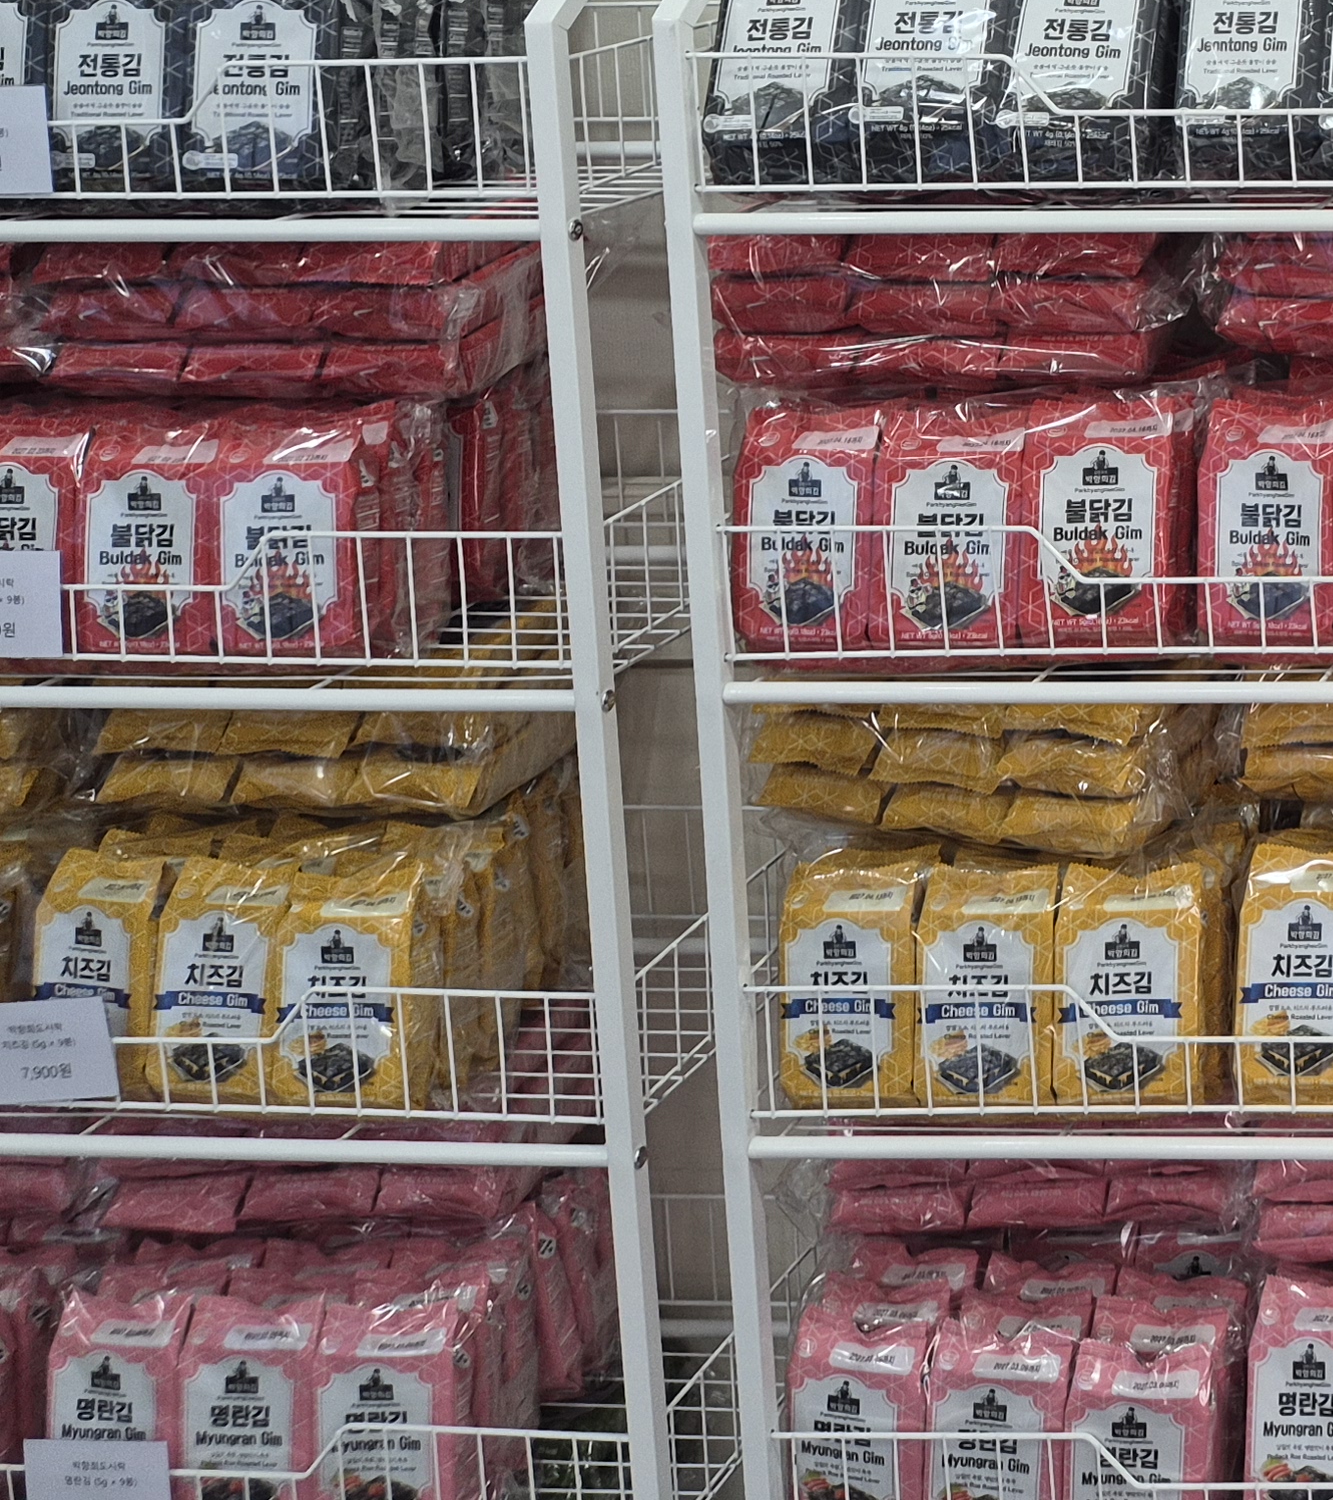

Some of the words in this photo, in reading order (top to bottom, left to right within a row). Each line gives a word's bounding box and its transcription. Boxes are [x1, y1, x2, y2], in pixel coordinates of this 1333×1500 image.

[746, 17, 814, 41] 전통김
[1043, 19, 1113, 42] 전통김
[1213, 11, 1279, 35] 전통김
[876, 37, 942, 52] Jeontong
[1025, 43, 1090, 59] Jeontong
[1095, 45, 1121, 59] Gim
[1197, 37, 1258, 53] Jeontong
[1263, 39, 1288, 52] Gim
[78, 53, 142, 78] 전통김
[64, 82, 124, 96] Jeontong
[129, 82, 152, 95] Gim
[1065, 498, 1133, 524] 불닭김
[1240, 503, 1302, 528] 불닭김
[110, 524, 174, 548] 불닭김
[1054, 526, 1107, 542] Buldak
[1115, 526, 1142, 540] Gim
[1230, 530, 1279, 545] Buldak
[1286, 532, 1310, 546] Gim
[100, 551, 151, 566] Buldak
[158, 553, 182, 566] Gim
[60, 956, 111, 982] 치즈김
[1271, 954, 1333, 978] 치즈김
[184, 964, 244, 988] 치즈김
[1089, 971, 1153, 996] 치즈김
[178, 991, 223, 1007] Cheese
[227, 993, 248, 1007] Gim
[1264, 984, 1311, 998] Cheese
[993, 1003, 1016, 1017] Gim
[1137, 1000, 1159, 1014] Gim
[21, 1063, 72, 1080] 7,900원
[76, 1398, 133, 1424] 명란김
[211, 1405, 270, 1428] 명란김
[61, 1424, 121, 1441] Myungran
[125, 1426, 146, 1441] Gim
[1263, 1421, 1323, 1438] Myungran
[261, 1431, 282, 1446] Gim
[399, 1437, 421, 1450] Gim
[863, 1450, 885, 1466] Gim
[1008, 1459, 1029, 1474] Gim
